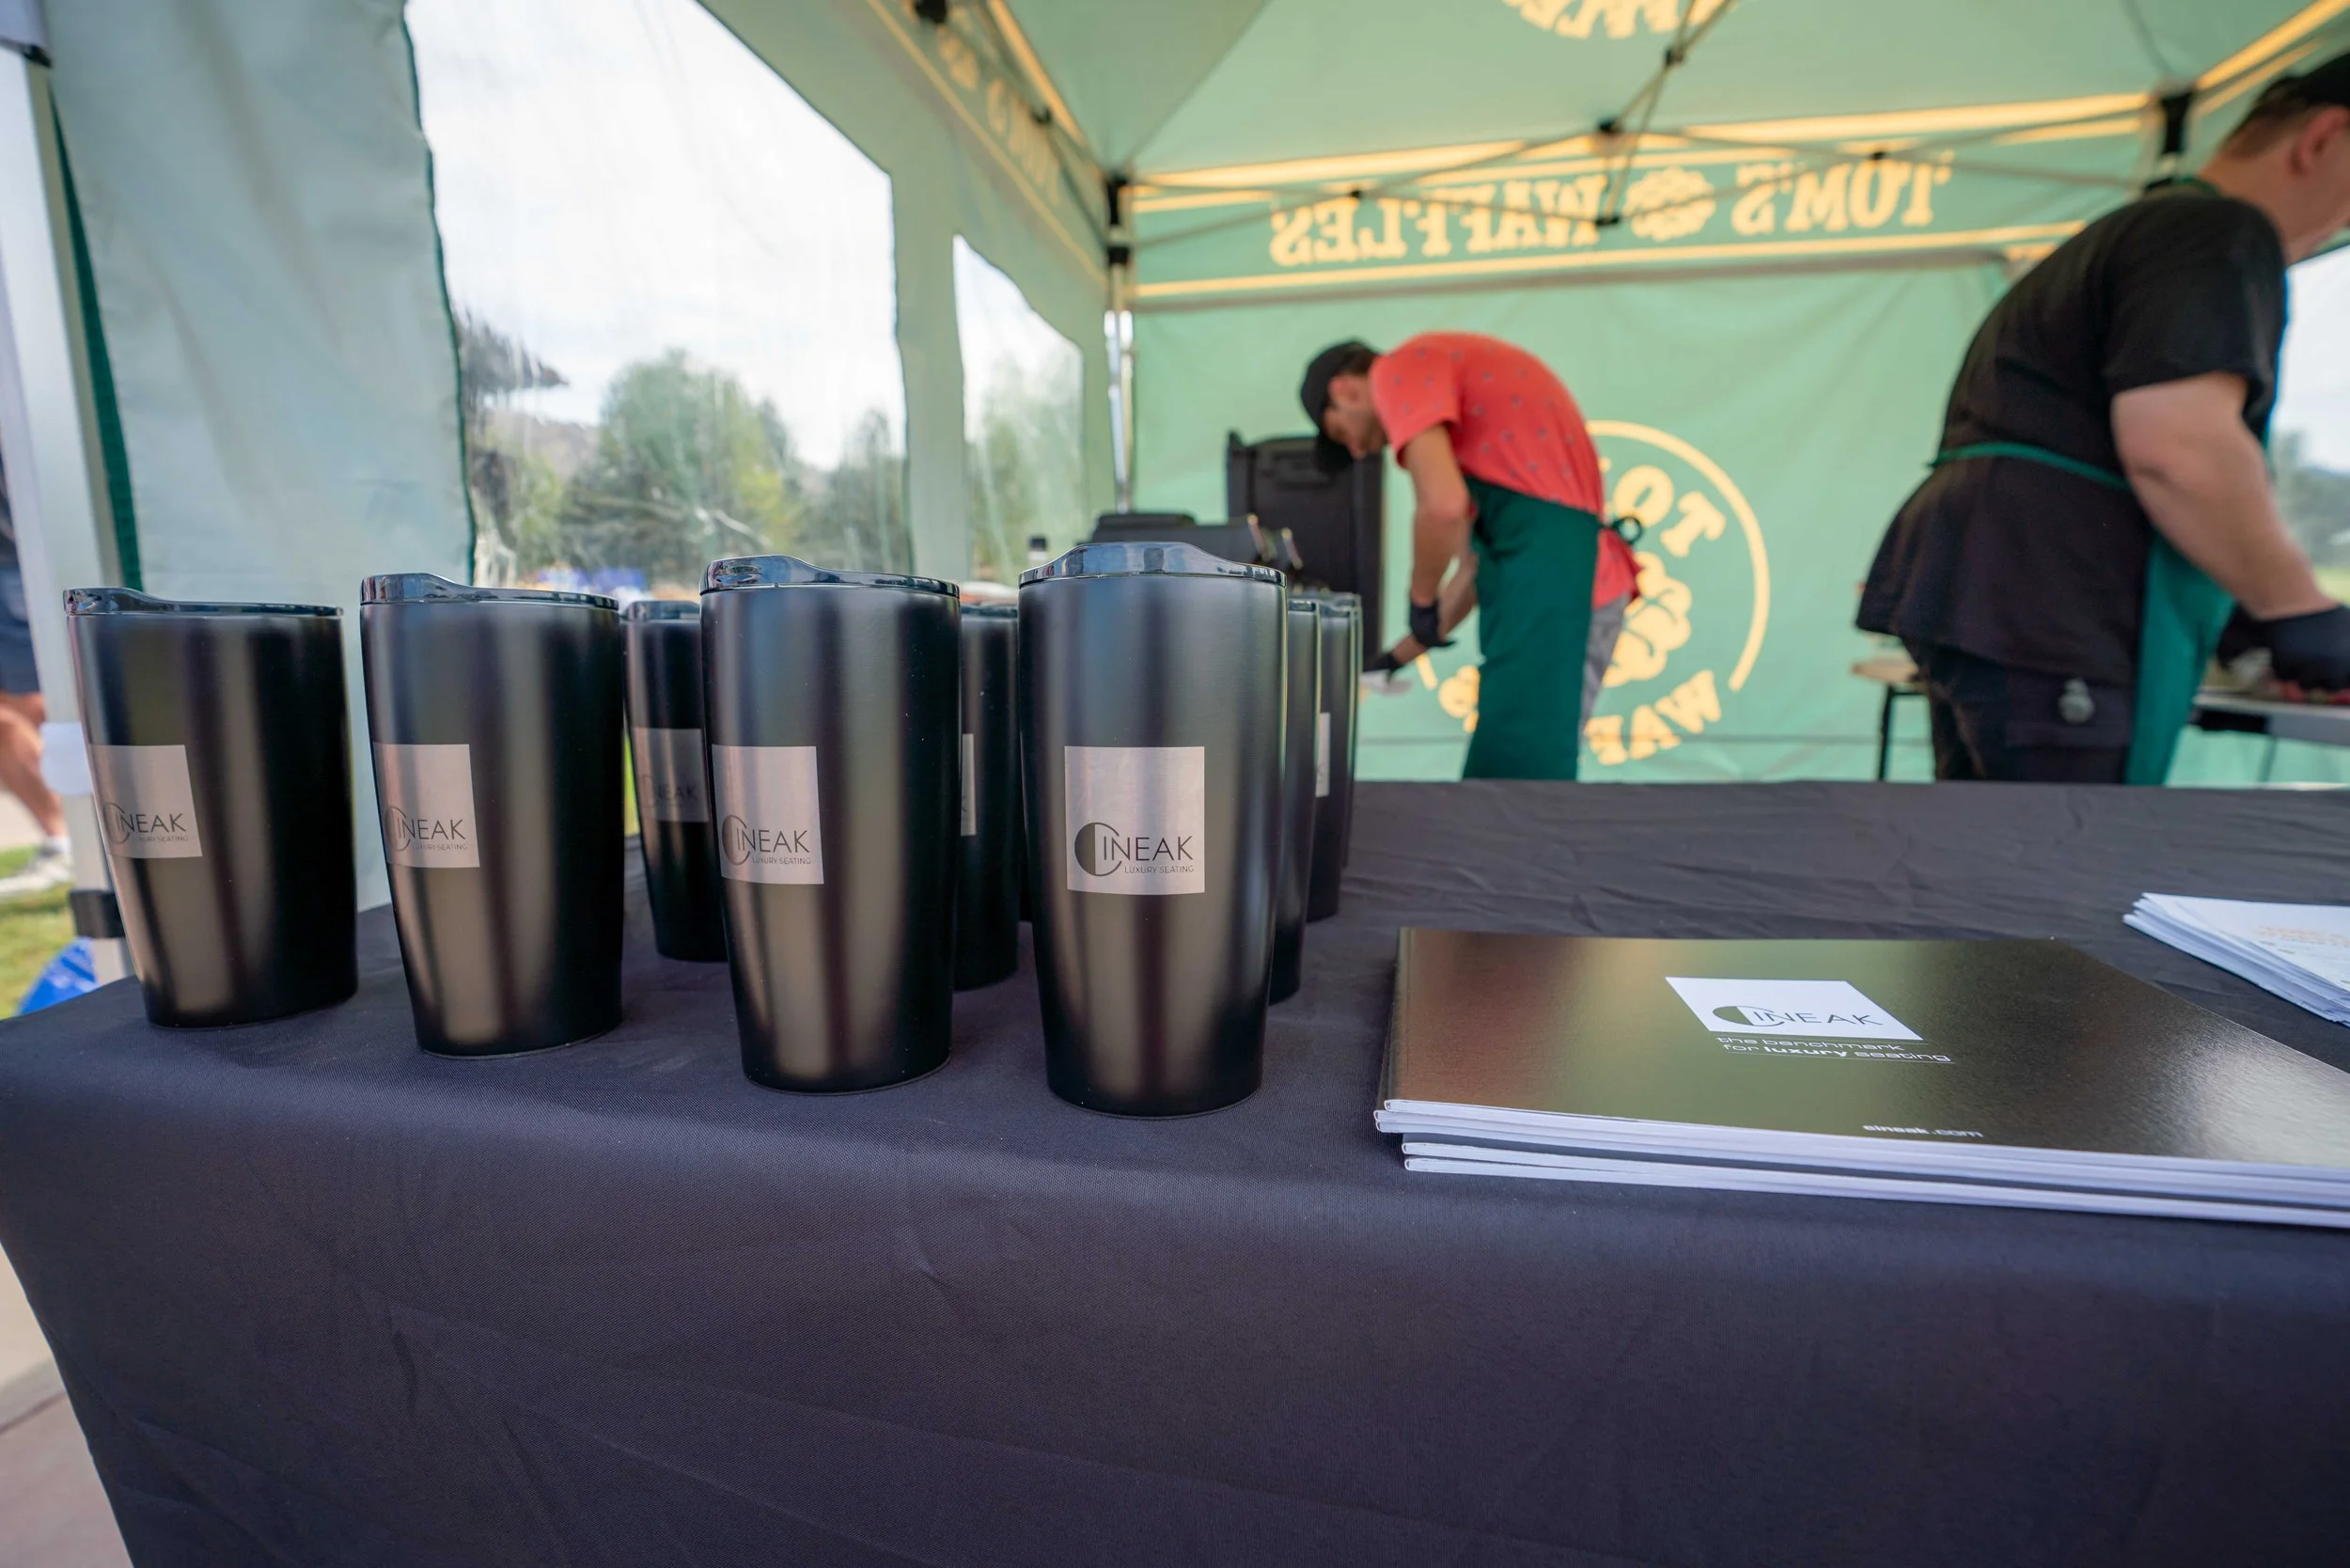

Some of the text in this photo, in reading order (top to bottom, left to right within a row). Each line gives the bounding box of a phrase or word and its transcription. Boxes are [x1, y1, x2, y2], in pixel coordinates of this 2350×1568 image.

[385, 807, 466, 852] CINEAK
[722, 814, 810, 866] CINEAK
[1074, 822, 1193, 877] CINEAK
[752, 856, 777, 865] LUXURY
[1124, 865, 1194, 874] LUXURY SEATING
[1712, 1005, 1884, 1027] CINEAK
[1716, 1037, 1905, 1052] the benchmark
[1722, 1043, 1952, 1062] for luxury seating
